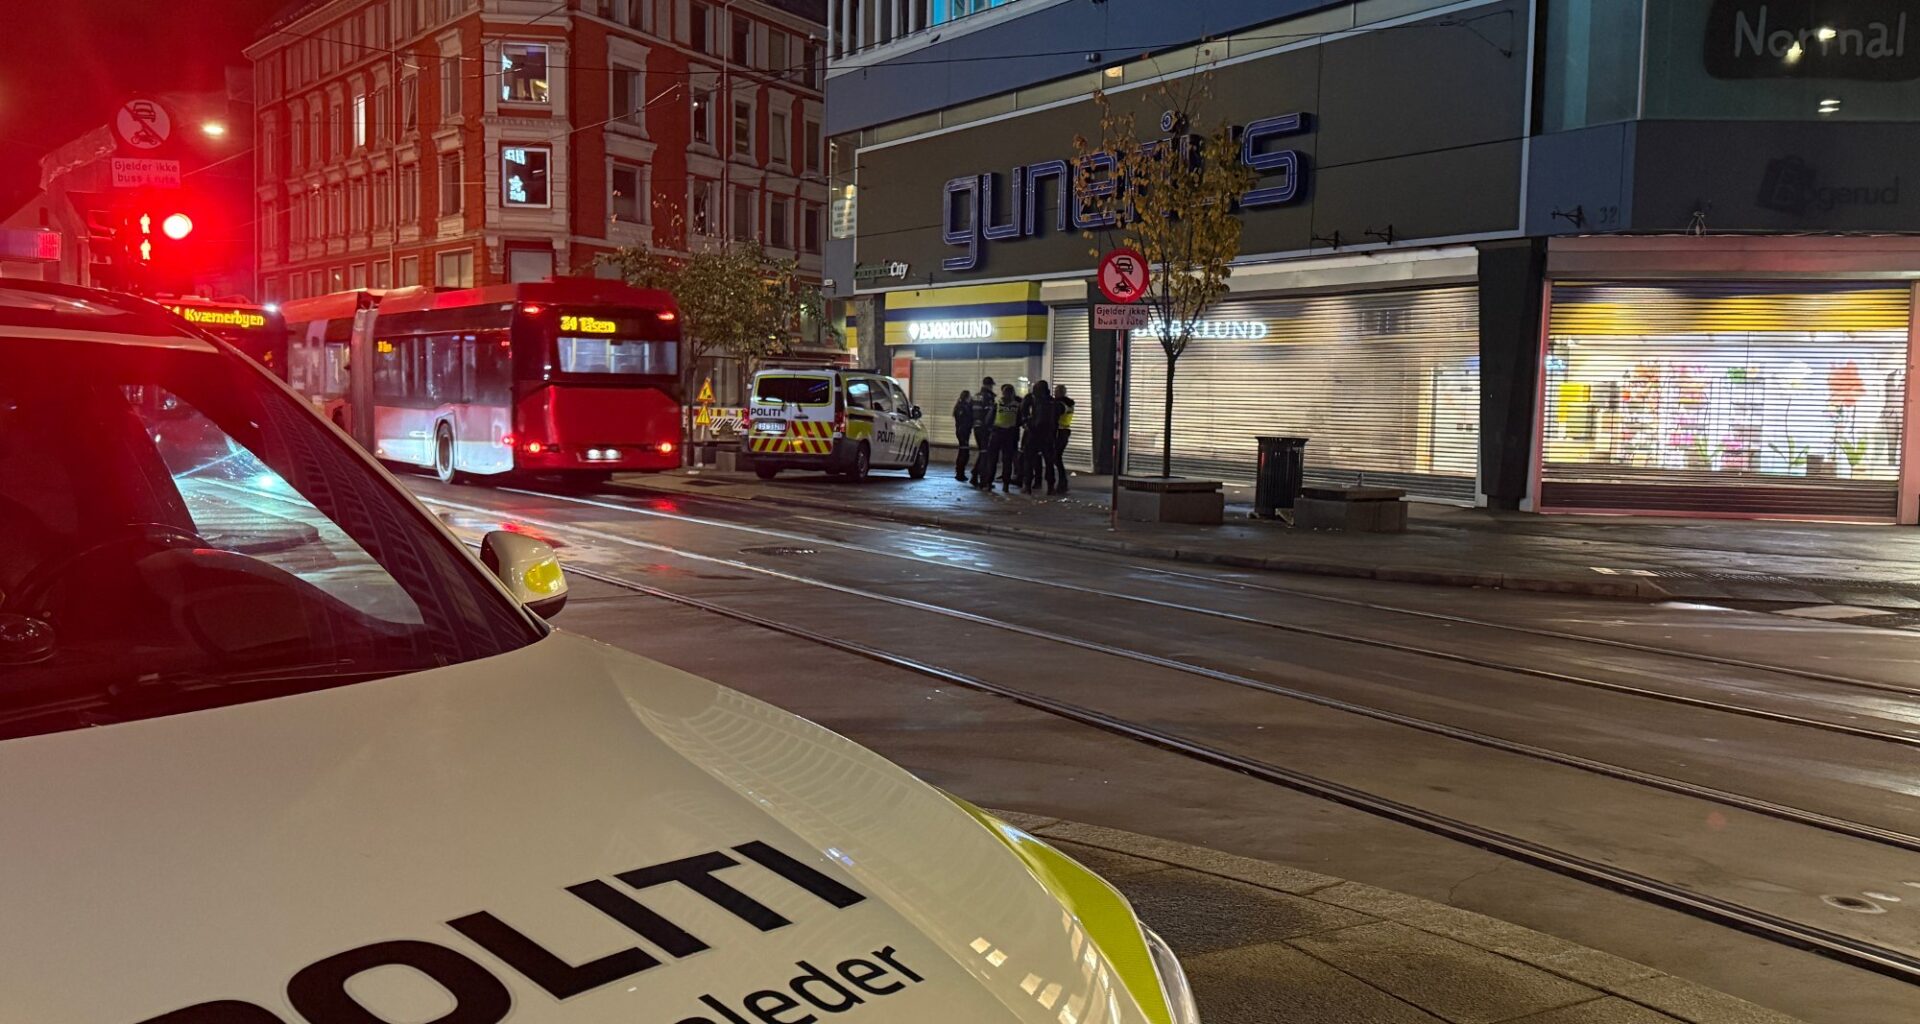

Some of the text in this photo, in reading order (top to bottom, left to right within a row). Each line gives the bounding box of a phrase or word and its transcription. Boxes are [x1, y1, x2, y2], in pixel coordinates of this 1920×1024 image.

[1734, 4, 1907, 59] Normal
[114, 161, 178, 172] Gjelder ikke
[117, 172, 143, 183] buss
[1599, 206, 1618, 224] 32
[890, 261, 909, 280] City
[184, 308, 264, 328] Kværnerbyen
[1096, 307, 1146, 316] Gjelder ikke
[1097, 317, 1118, 326] buss
[919, 320, 992, 339] BJØRKLUND
[750, 407, 782, 417] POLITI
[876, 430, 896, 443] POLITI
[675, 945, 925, 1024] leder
